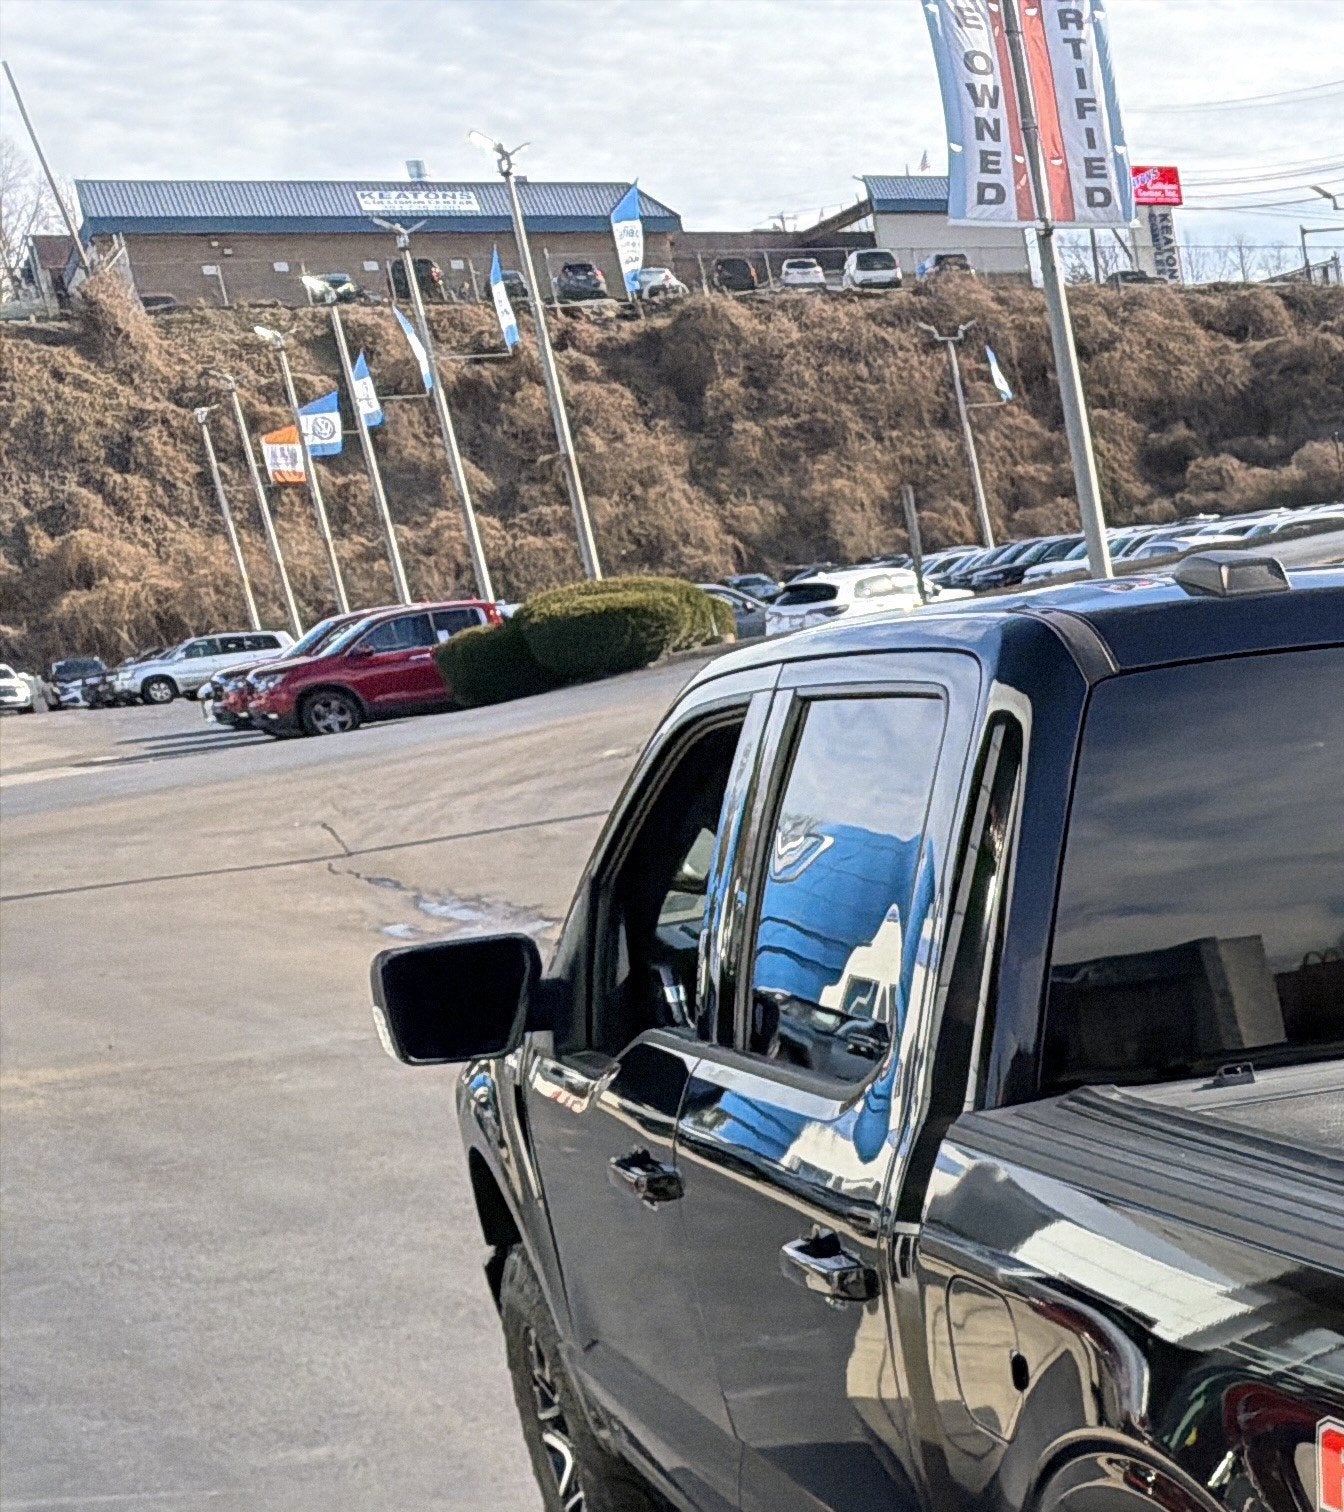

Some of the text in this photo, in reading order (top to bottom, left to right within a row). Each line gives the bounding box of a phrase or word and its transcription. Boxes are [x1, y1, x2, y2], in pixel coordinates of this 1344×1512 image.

[963, 49, 1007, 206] OWNED
[1057, 0, 1112, 208] RTIFIED
[360, 192, 472, 200] KEATONS
[1159, 213, 1179, 280] KEATON
